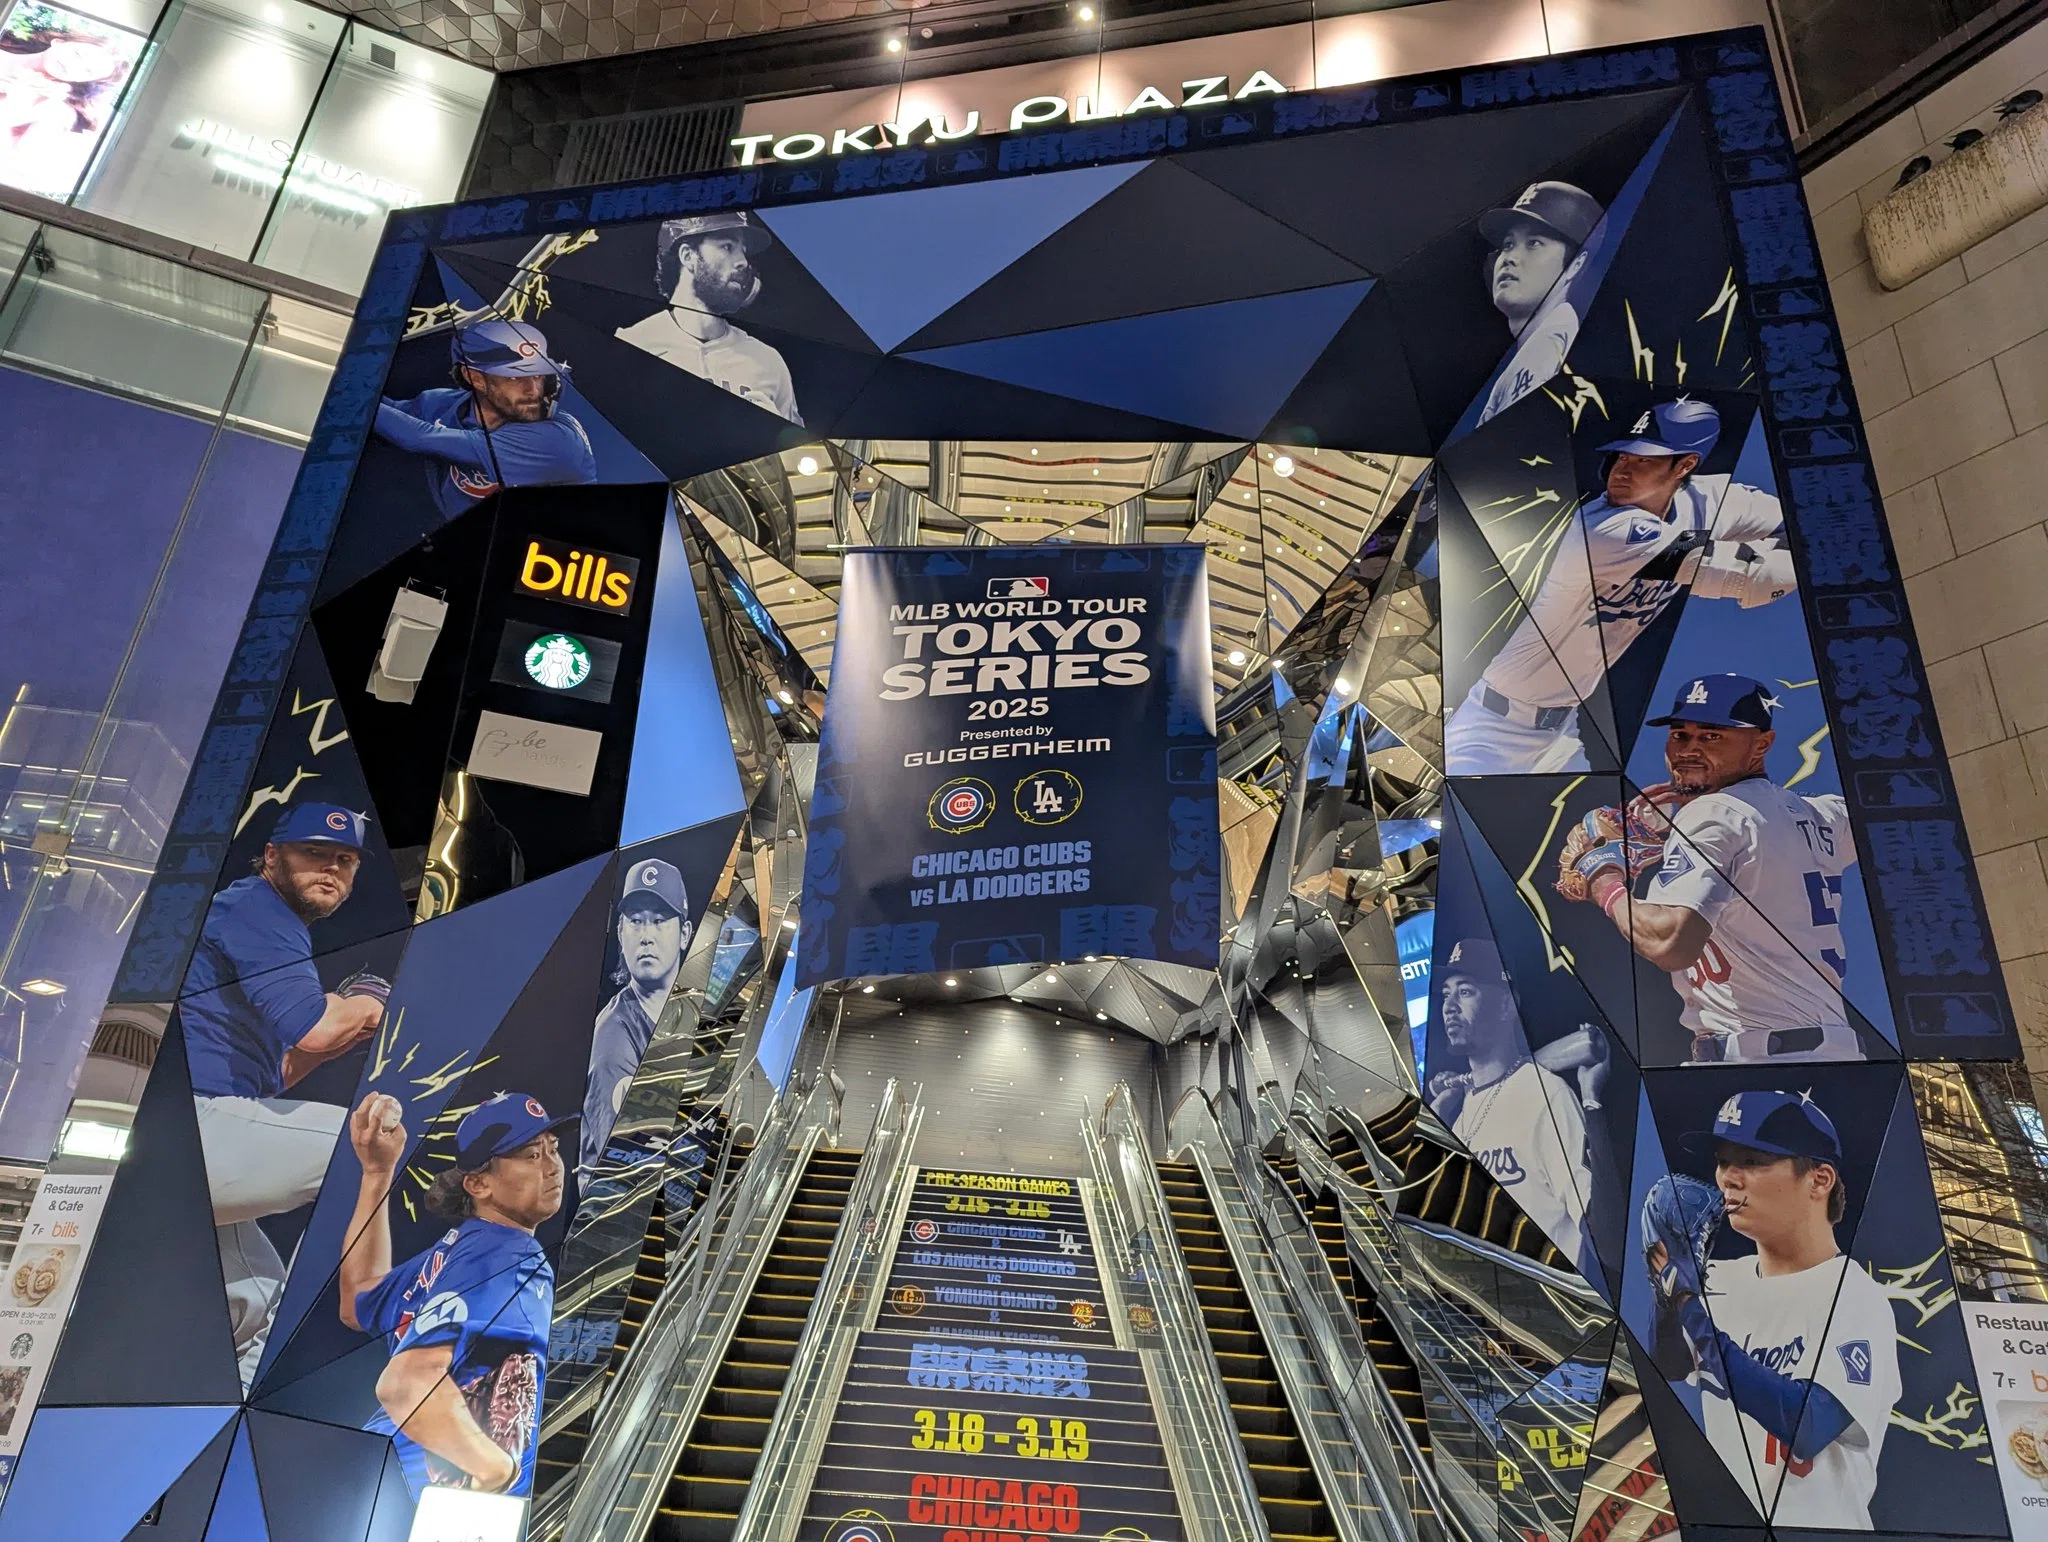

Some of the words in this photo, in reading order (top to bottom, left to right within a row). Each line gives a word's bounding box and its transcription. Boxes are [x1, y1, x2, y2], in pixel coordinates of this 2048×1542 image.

[730, 110, 981, 167] TOKYU
[1010, 69, 1288, 131] PLAZA
[521, 541, 631, 607] bills
[889, 603, 950, 622] MLB
[955, 600, 1062, 618] WORLD
[1067, 597, 1147, 615] TOUR
[893, 618, 1141, 659] TOKYO
[879, 652, 1151, 701] SERIES
[967, 696, 1050, 721] 2025
[960, 725, 1033, 742] Presented
[1036, 725, 1054, 738] by
[903, 737, 1111, 768] GUGGENHEIM
[1033, 780, 1063, 814] LA
[911, 845, 1020, 878] CHICAGO
[1023, 840, 1092, 867] CUBS
[937, 879, 969, 904] LA
[972, 869, 1090, 901] DODGERS
[43, 1183, 103, 1196] Restaurant
[925, 1171, 1017, 1191] PRE-SEASON
[1020, 1177, 1071, 1197] GAMES
[48, 1200, 57, 1212] &
[58, 1200, 84, 1212] Cafe
[51, 1221, 80, 1239] bills
[912, 1250, 941, 1266] LOS
[934, 1286, 998, 1306] YOMIURI
[0, 1310, 20, 1318] OPEN
[2002, 1340, 2016, 1354] &
[911, 1409, 985, 1453] 3.18
[1016, 1416, 1090, 1461] 3.19
[908, 1474, 1081, 1534] CHICAGO
